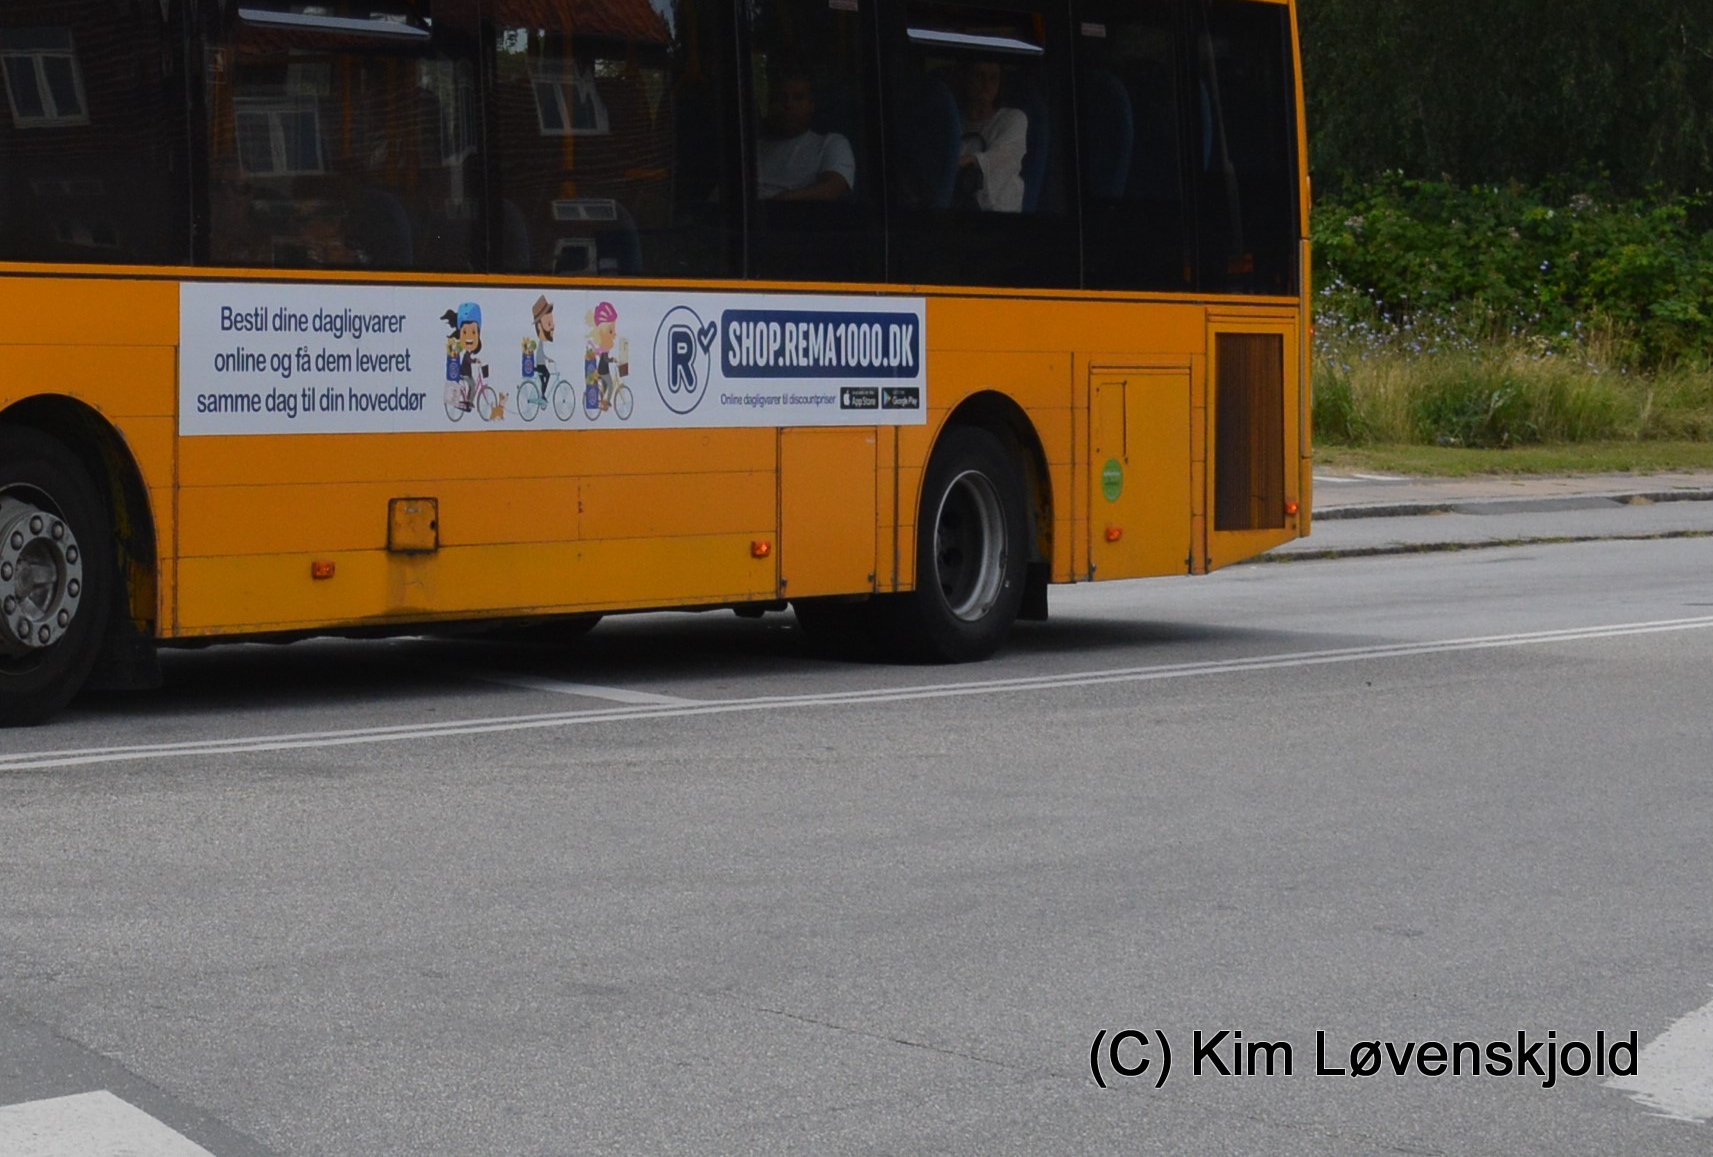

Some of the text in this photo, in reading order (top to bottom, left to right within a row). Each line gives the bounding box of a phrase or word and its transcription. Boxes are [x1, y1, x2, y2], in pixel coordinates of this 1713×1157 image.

[221, 306, 406, 339] Bestil dine dagligvarer
[728, 320, 913, 368] SHOP.REMA1000.DK
[214, 345, 411, 378] online og få dem leveret
[197, 386, 426, 418] samme dag til din hoveddør
